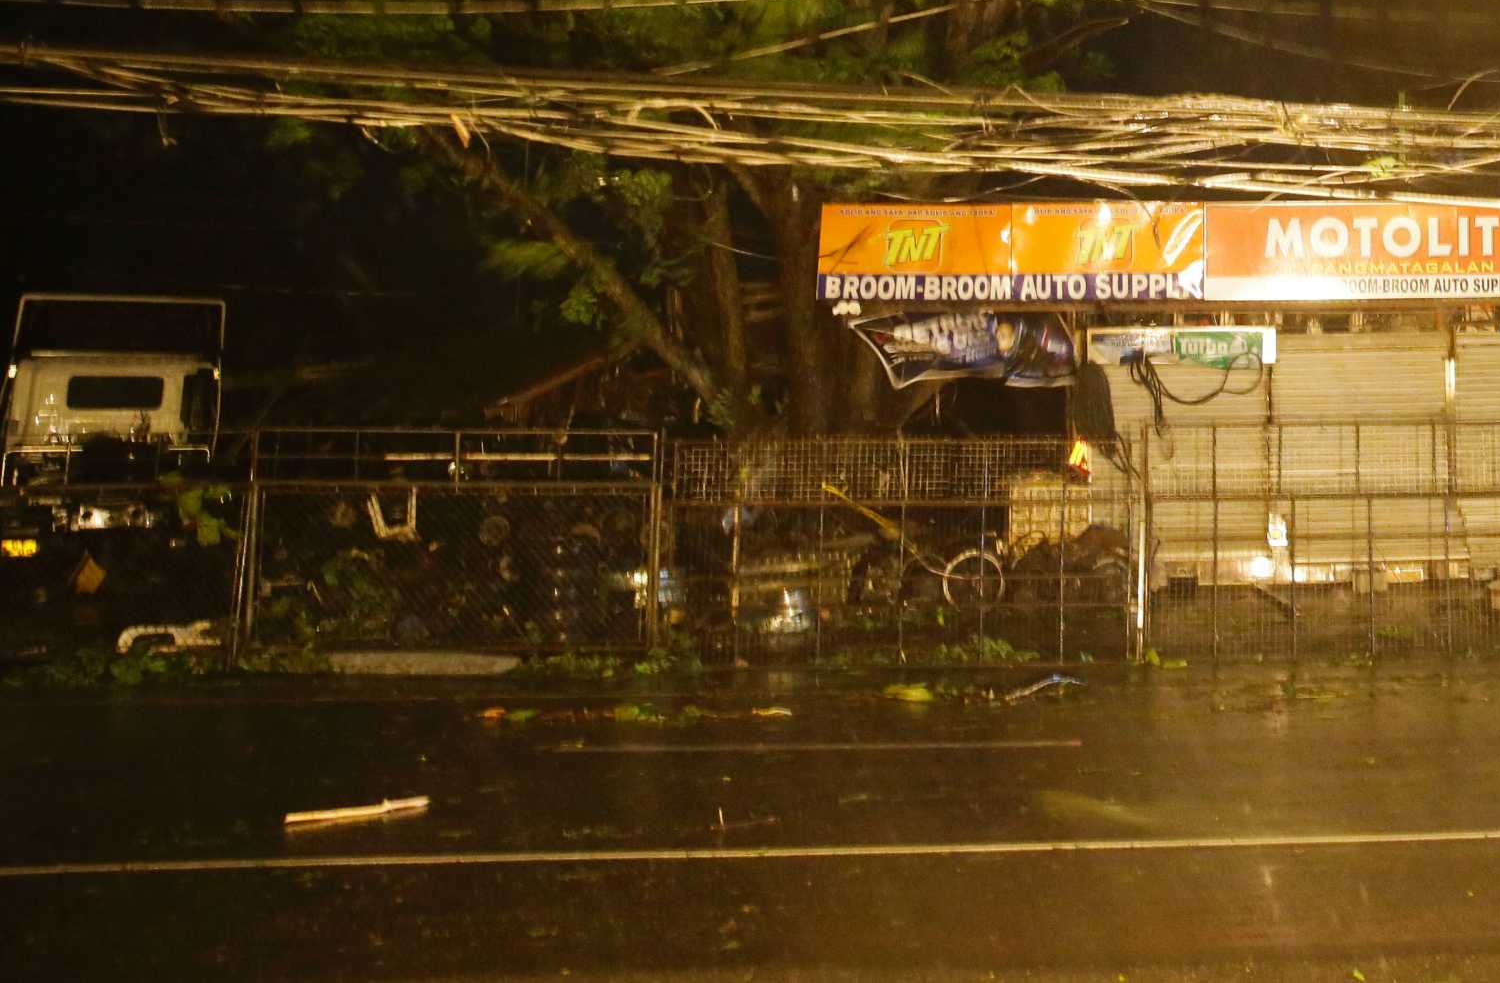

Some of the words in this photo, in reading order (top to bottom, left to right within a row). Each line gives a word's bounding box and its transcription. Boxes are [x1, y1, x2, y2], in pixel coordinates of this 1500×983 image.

[885, 223, 950, 267] TNT
[1077, 223, 1136, 266] TNT
[825, 275, 1011, 300] BROOM-BROOM
[1021, 274, 1087, 301] AUTO
[1434, 278, 1469, 293] AUTO
